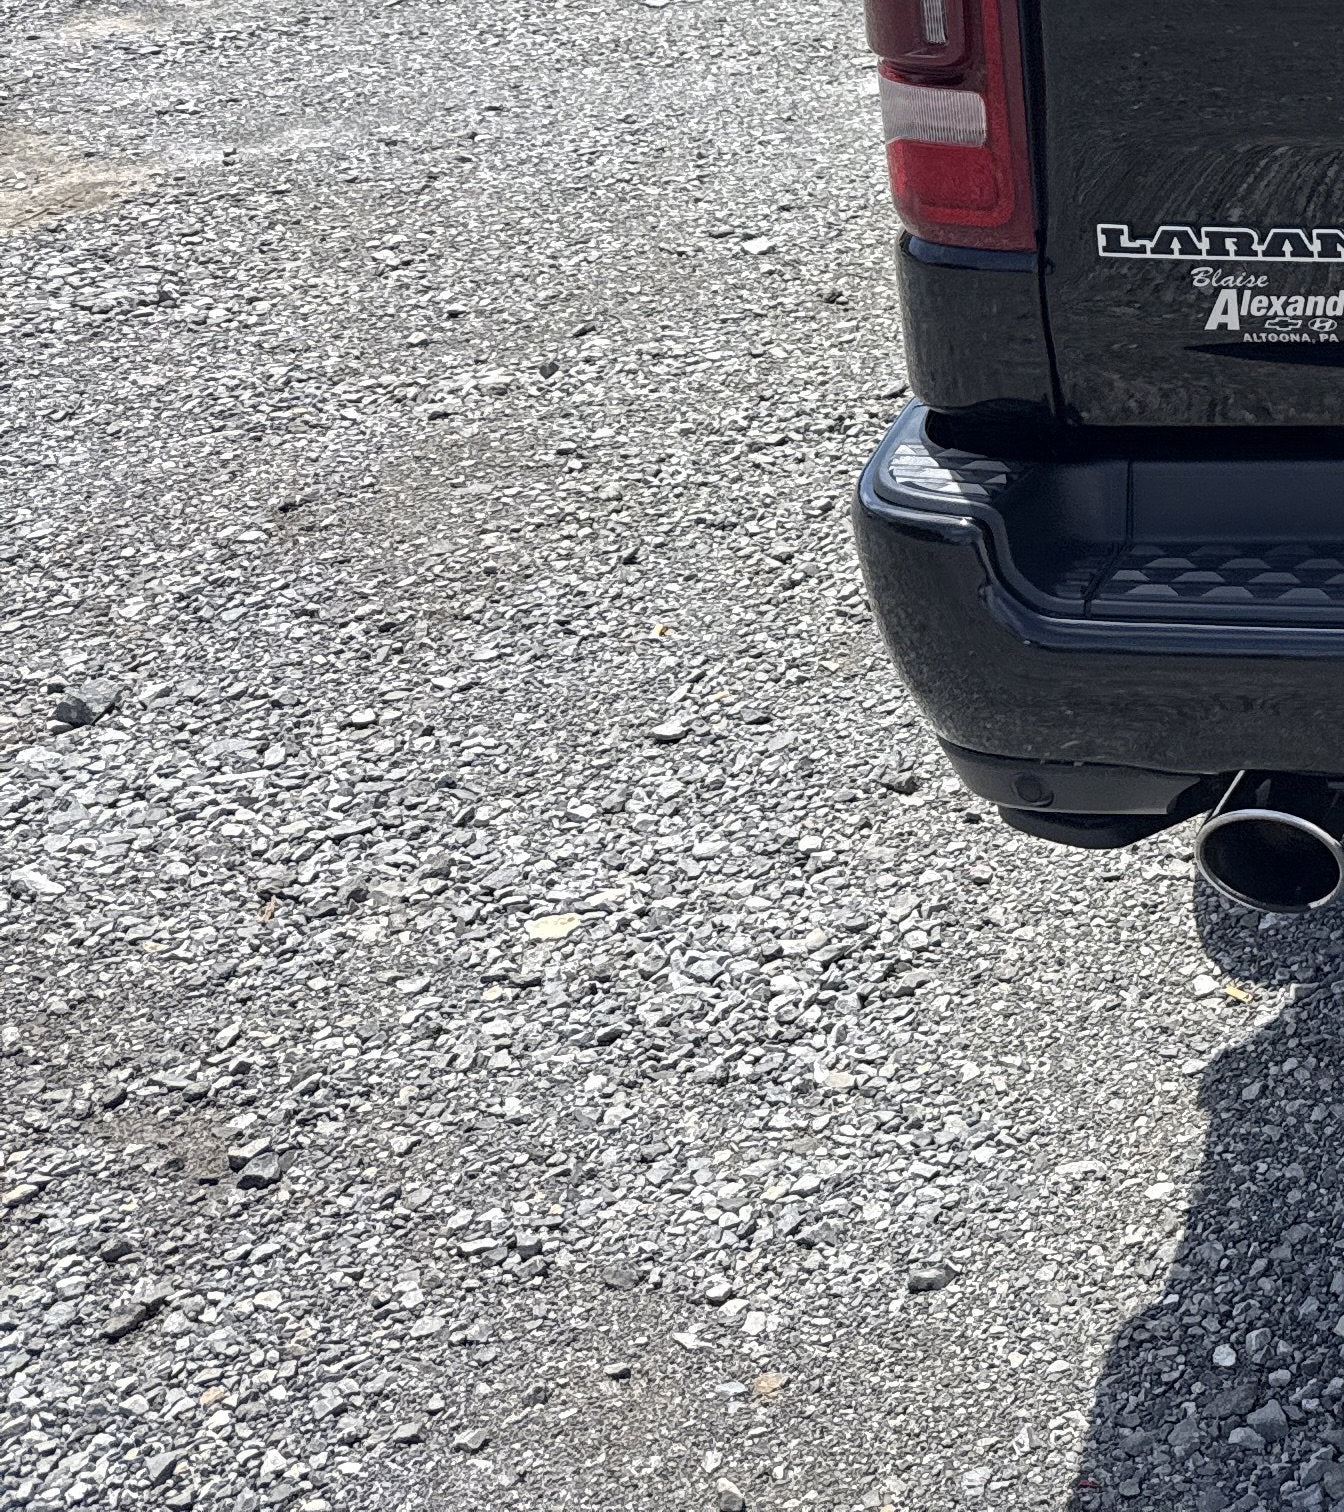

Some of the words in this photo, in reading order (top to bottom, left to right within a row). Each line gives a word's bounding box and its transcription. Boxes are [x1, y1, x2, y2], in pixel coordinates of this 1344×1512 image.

[1190, 266, 1270, 288] Blaise
[1242, 332, 1316, 345] ALTOONA,
[1318, 332, 1340, 344] PA
